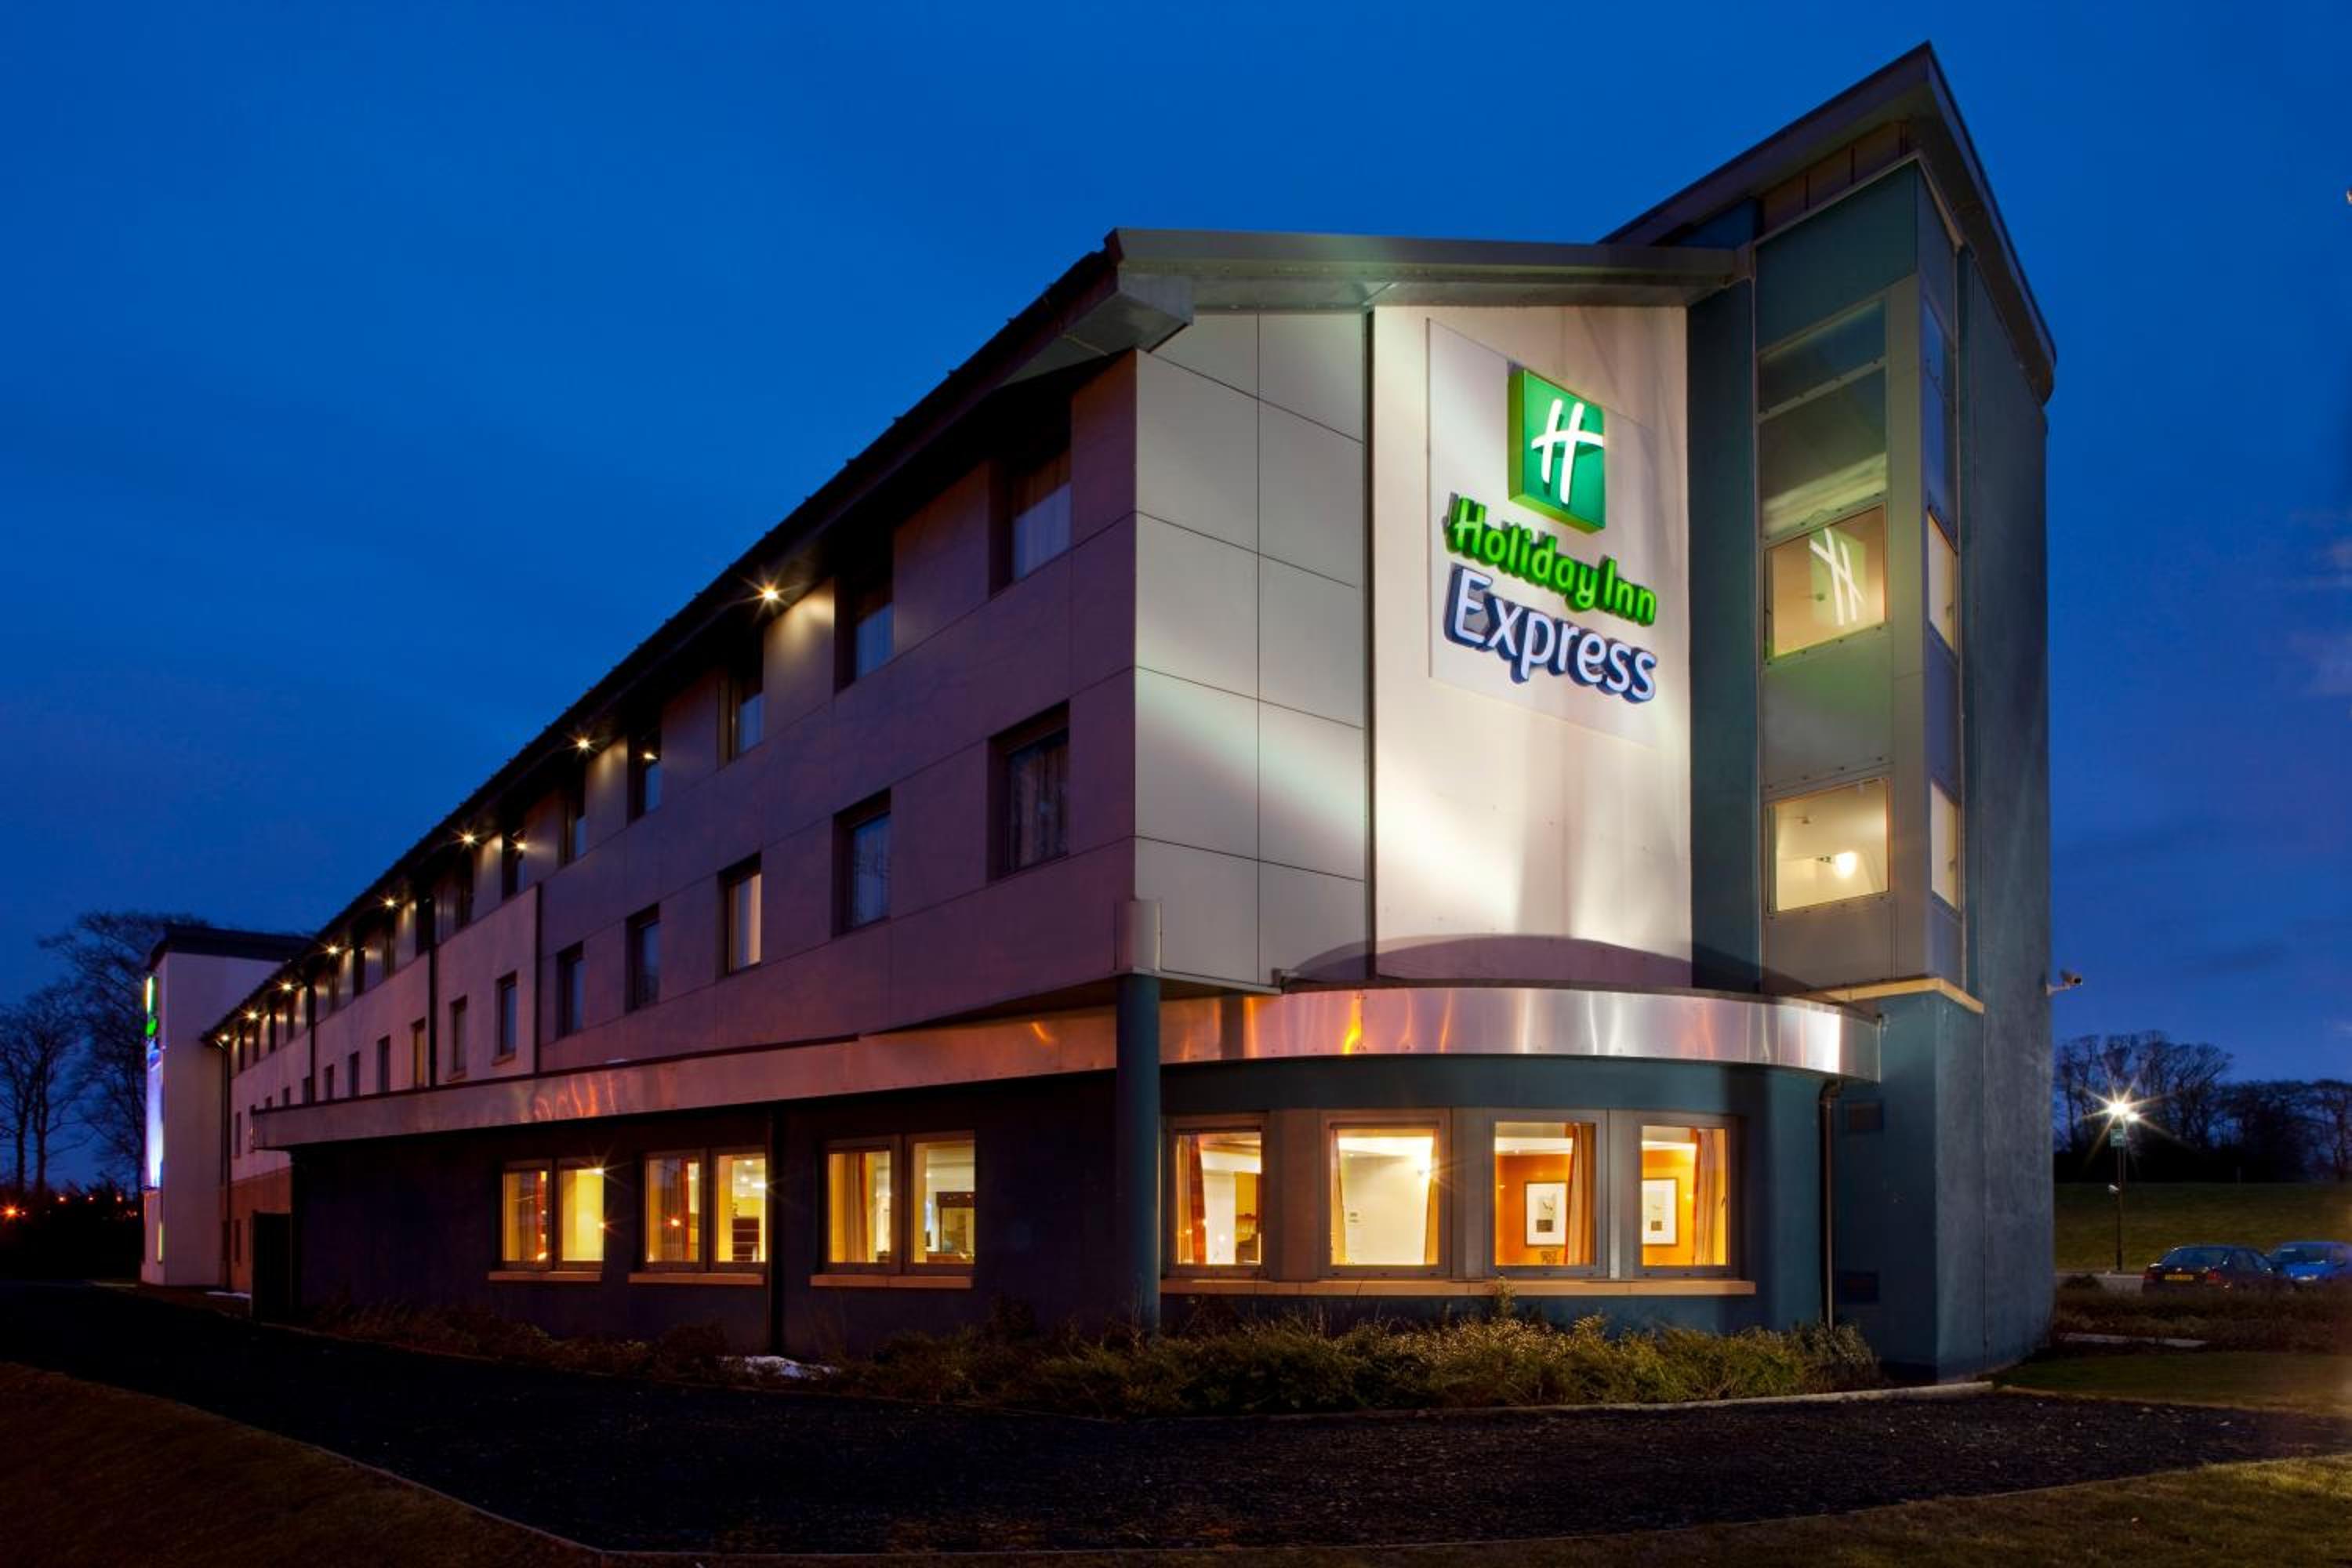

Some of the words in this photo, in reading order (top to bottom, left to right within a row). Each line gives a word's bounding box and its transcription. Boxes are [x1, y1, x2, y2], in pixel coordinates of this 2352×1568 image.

[1449, 496, 1599, 609] Holiday
[1602, 556, 1657, 626] Inn
[1448, 567, 1657, 702] Express
